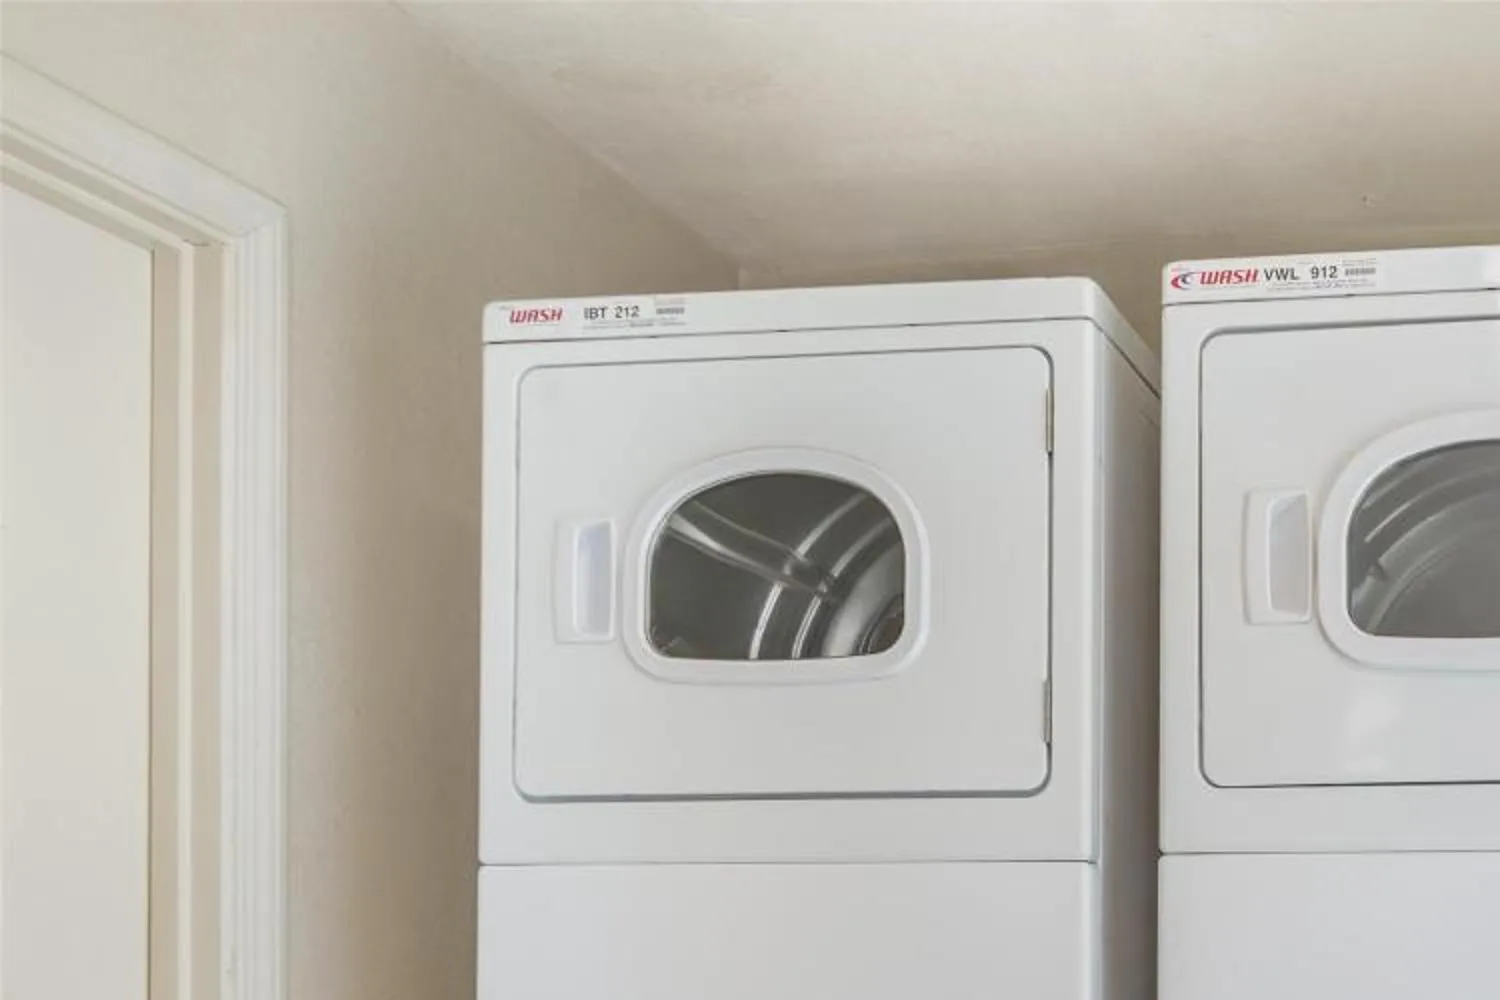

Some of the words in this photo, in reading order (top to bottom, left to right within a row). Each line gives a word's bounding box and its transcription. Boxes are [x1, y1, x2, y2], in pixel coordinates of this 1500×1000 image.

[1200, 268, 1259, 285] WASH
[1264, 266, 1300, 281] VWL
[1310, 265, 1339, 279] 912
[509, 307, 564, 324] WASH
[615, 305, 641, 319] 212
